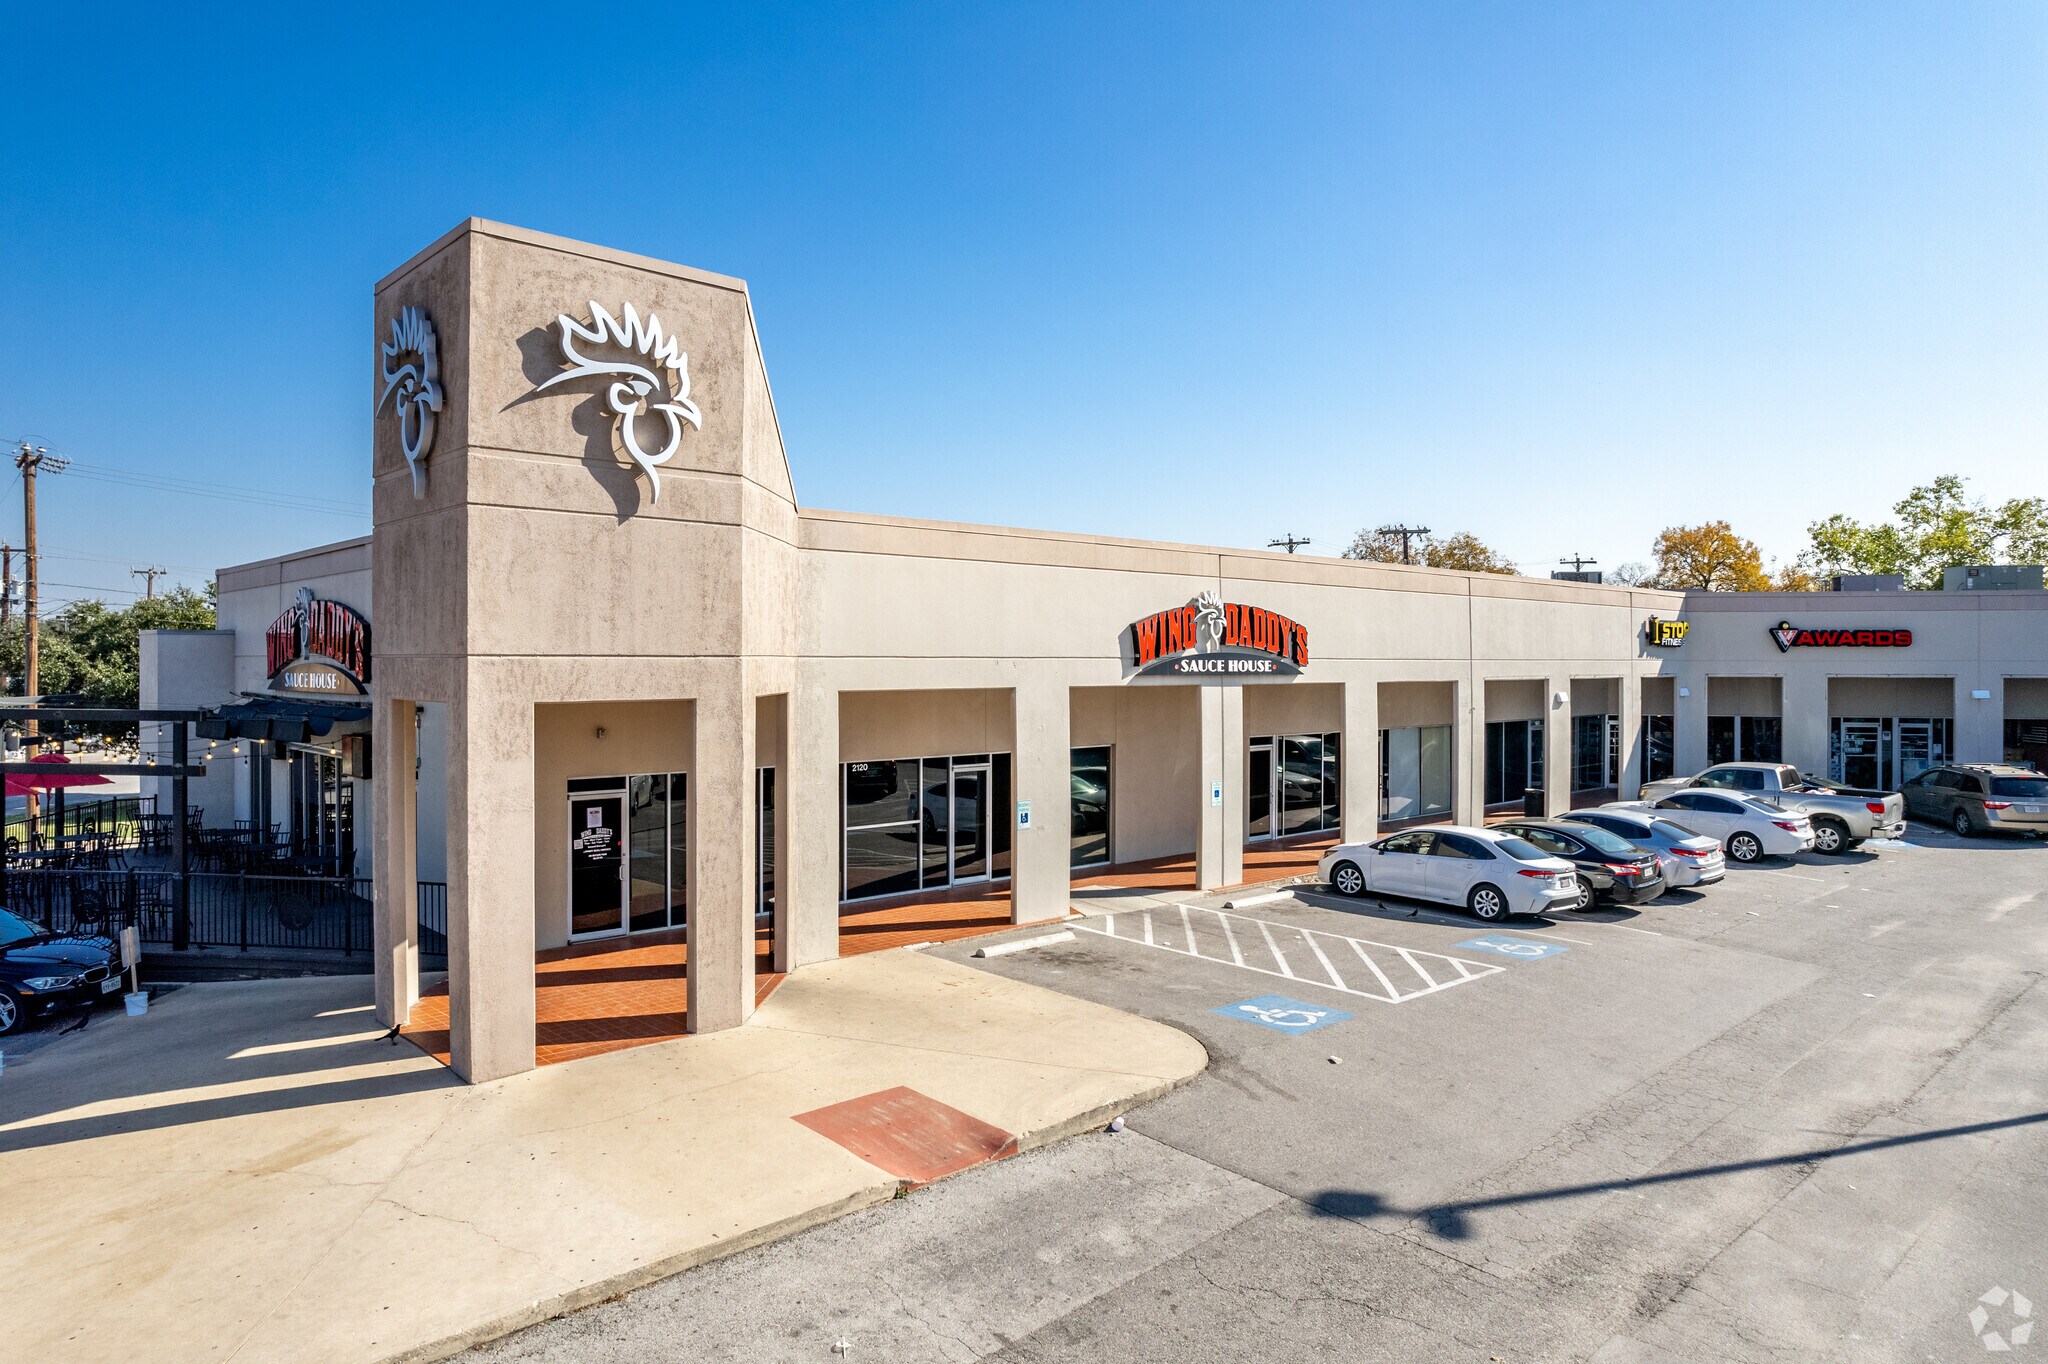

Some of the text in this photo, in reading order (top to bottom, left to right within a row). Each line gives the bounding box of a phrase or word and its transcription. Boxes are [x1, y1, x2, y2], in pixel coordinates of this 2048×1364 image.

[1136, 603, 1308, 667] WING DADDY'S
[1662, 621, 1690, 639] STOP
[1796, 631, 1912, 645] AWARDS
[266, 600, 364, 682] WING DADDY'S
[1180, 659, 1272, 673] SAUCE HOUSE
[284, 672, 337, 689] SAUCE HOUSE
[852, 763, 868, 772] 2120
